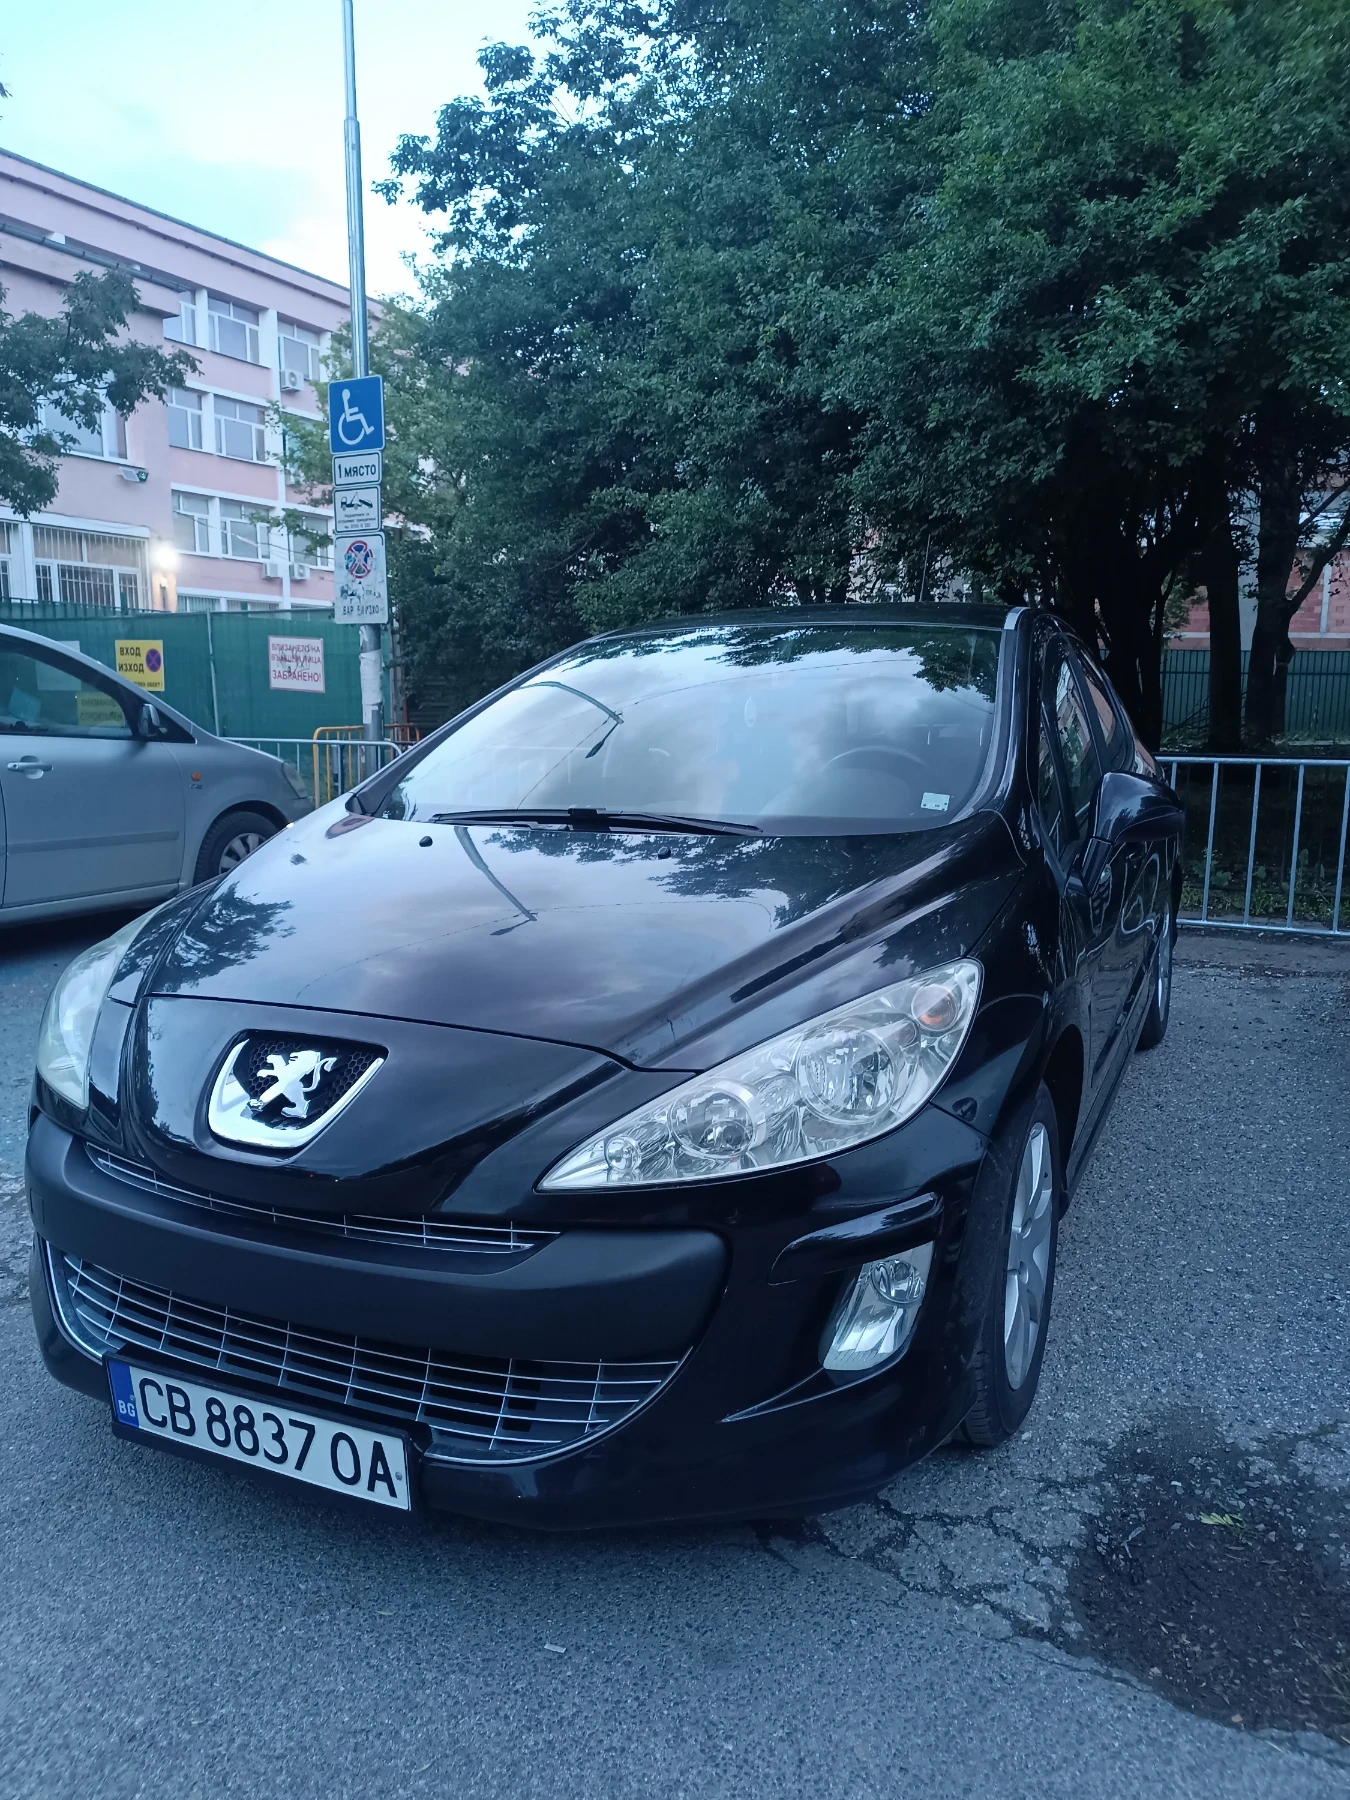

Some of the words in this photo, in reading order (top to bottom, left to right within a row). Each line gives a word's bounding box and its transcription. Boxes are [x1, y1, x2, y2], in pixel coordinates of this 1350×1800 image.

[338, 463, 342, 479] 1
[344, 464, 377, 478] МЯСТО
[119, 646, 141, 658] ВХОД
[311, 645, 321, 653] НА
[118, 663, 144, 674] ИЗХОД
[272, 669, 322, 683] ЗАБРАНЕНО!
[117, 1398, 136, 1418] BG
[138, 1377, 196, 1437] CB
[205, 1396, 316, 1472] 8837
[330, 1431, 398, 1499] OA
